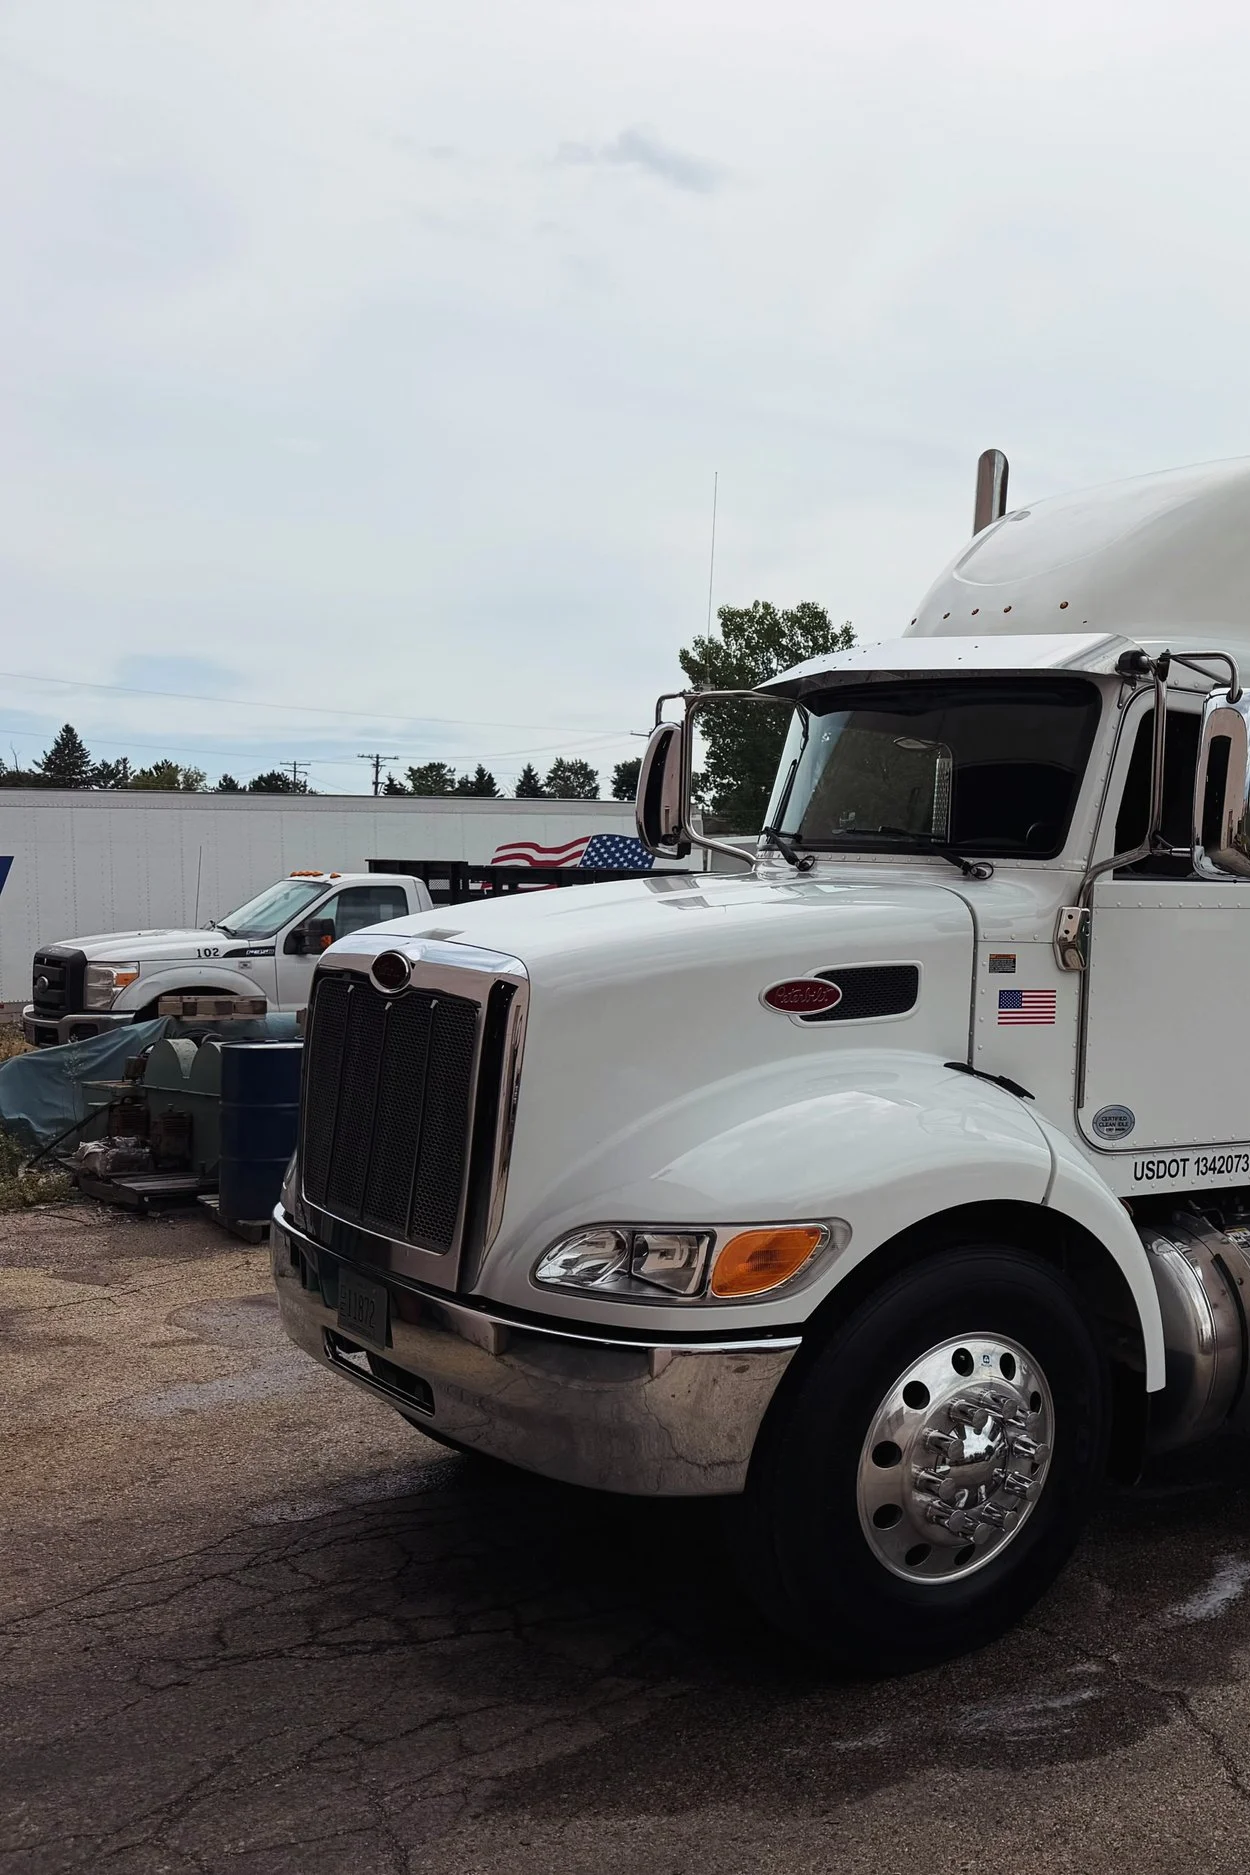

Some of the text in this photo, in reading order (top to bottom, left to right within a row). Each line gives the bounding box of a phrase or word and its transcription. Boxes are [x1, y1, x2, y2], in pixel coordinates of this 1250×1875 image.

[196, 948, 220, 959] 102
[1133, 1154, 1250, 1182] USDOT 1342073
